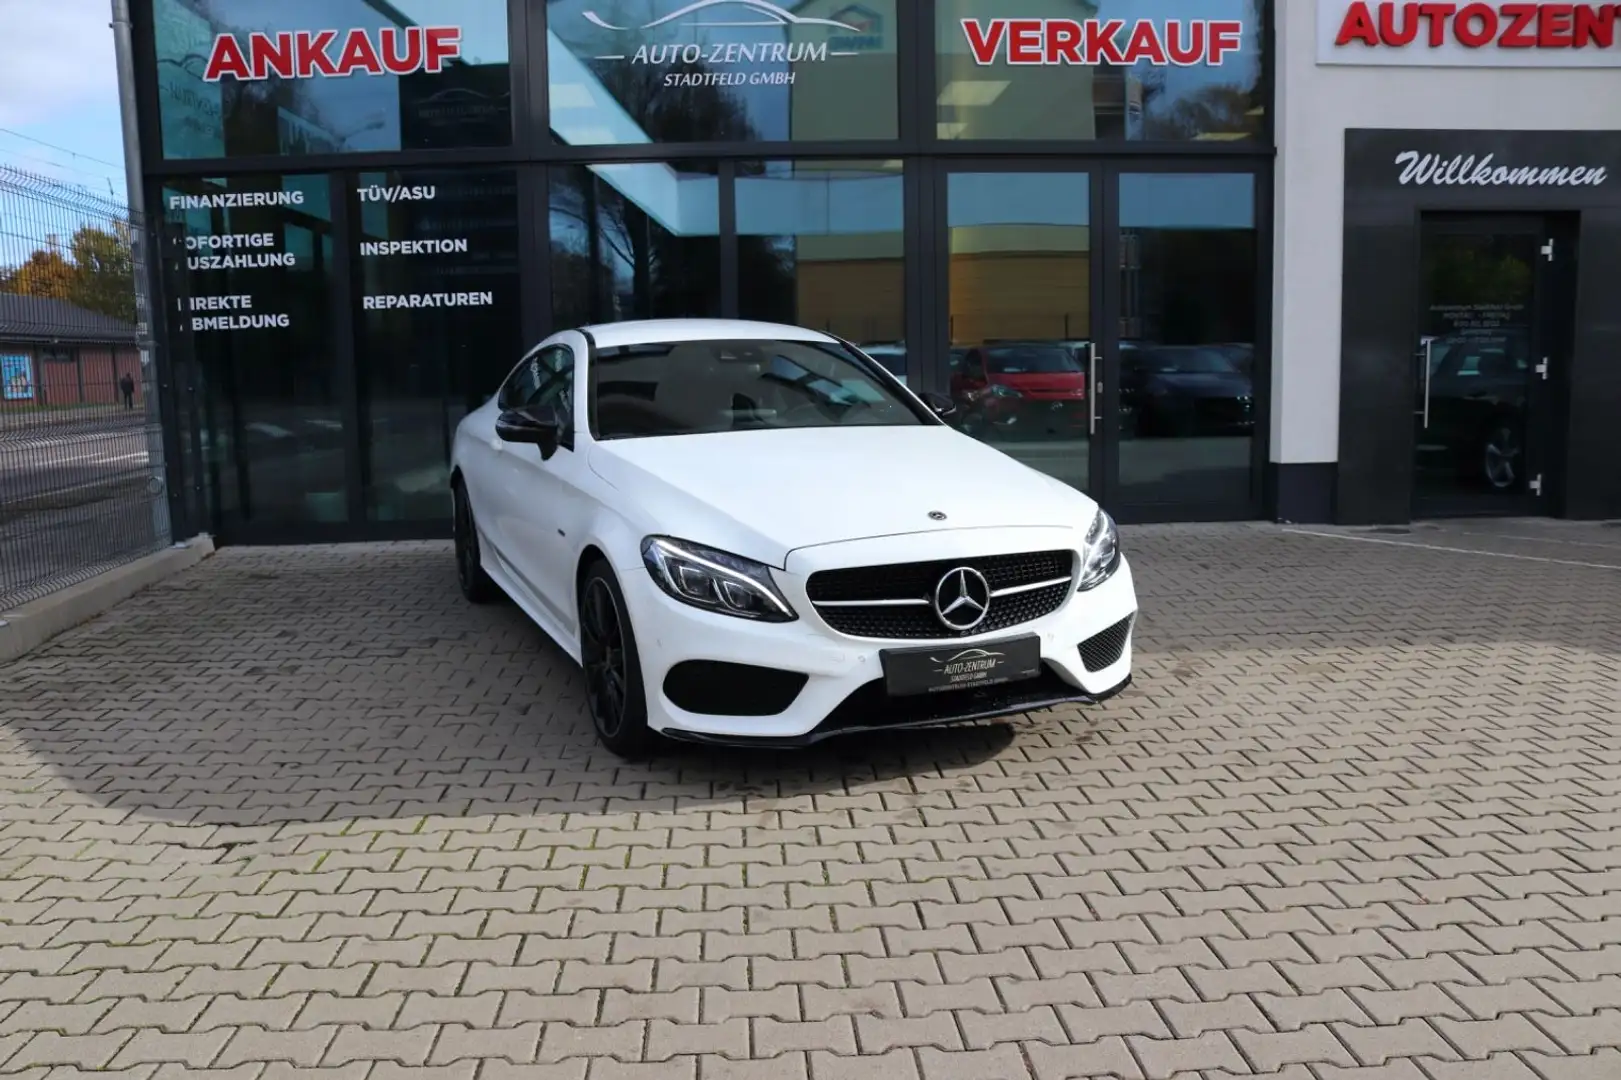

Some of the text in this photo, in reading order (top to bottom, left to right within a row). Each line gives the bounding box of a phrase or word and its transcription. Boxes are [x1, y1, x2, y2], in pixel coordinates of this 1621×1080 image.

[1335, 1, 1621, 48] AUTOZEN
[961, 19, 1242, 66] VERKAUF
[203, 26, 461, 82] ANKAUF
[632, 42, 828, 65] AUTO-ZENTRUM
[663, 71, 797, 88] STADTFELD GMBH
[1394, 149, 1608, 187] Willkommen
[169, 190, 304, 210] FINANZIERUNG
[357, 184, 436, 203] TÜV/ASU
[360, 238, 468, 256] INSPEKTION
[175, 252, 296, 271] USZAHLUNG
[177, 295, 252, 312] IREKTE
[362, 290, 493, 310] REPARATUREN
[179, 313, 290, 332] BMELDUNG
[943, 658, 996, 674] AUTO-ZENTRUM
